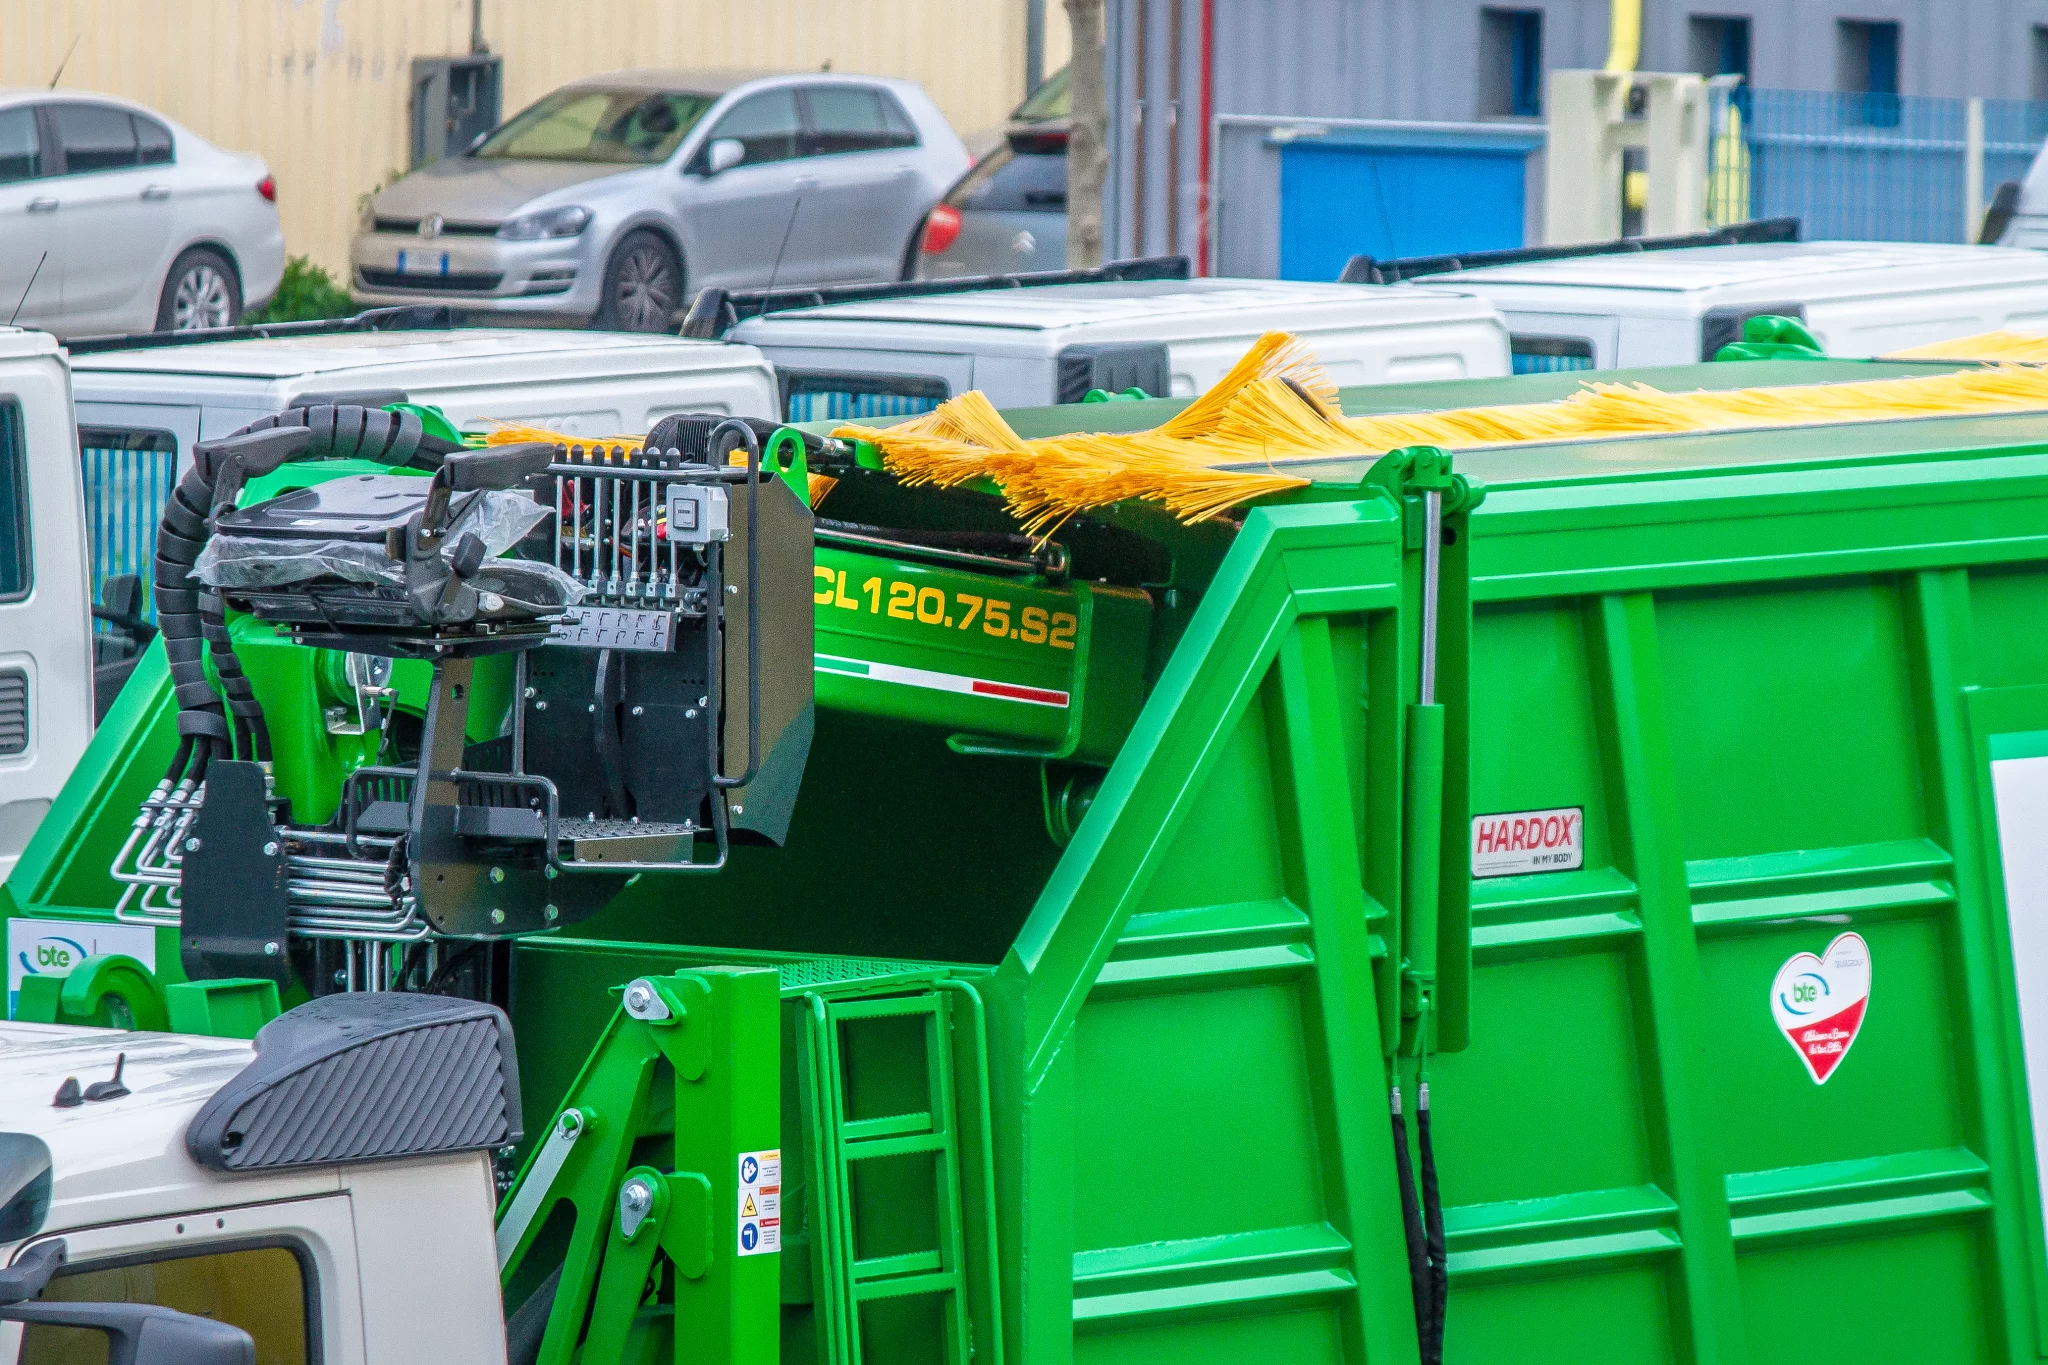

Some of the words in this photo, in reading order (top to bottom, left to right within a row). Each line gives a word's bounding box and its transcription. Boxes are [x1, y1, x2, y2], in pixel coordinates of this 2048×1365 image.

[1533, 856, 1541, 865] IN
[1542, 855, 1553, 864] MY
[1554, 853, 1573, 863] BODY
[37, 944, 70, 967] bte
[1793, 982, 1817, 1003] bte
